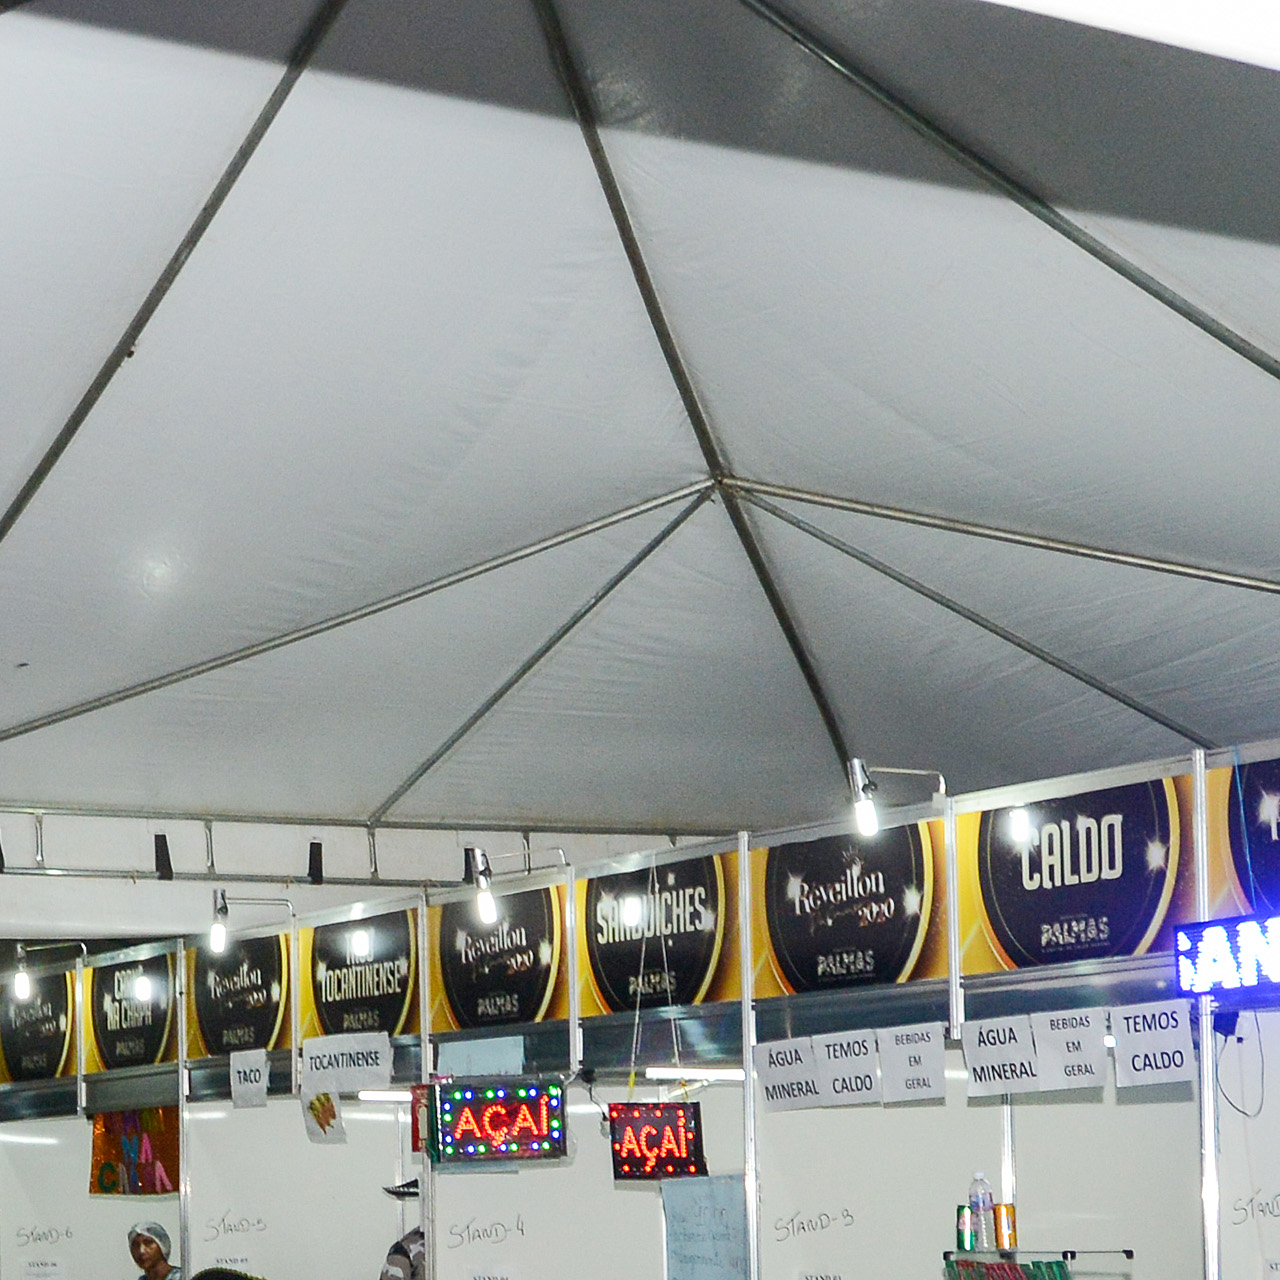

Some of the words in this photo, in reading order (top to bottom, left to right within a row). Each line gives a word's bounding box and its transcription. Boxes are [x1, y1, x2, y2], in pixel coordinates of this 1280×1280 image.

[1021, 814, 1124, 891] CALDO
[1041, 917, 1110, 947] PALMAS
[817, 950, 876, 977] PALMAS
[321, 960, 402, 1003] TOCANTINENSE
[1050, 1016, 1091, 1031] BEBIDAS
[1124, 1011, 1179, 1033] TEMOS
[895, 1032, 932, 1046] BEBIDAS
[977, 1024, 1018, 1047] ÁGUA
[768, 1046, 803, 1068] ÁGUA
[825, 1040, 869, 1060] TEMOS
[1066, 1041, 1082, 1053] EM
[309, 1051, 380, 1071] TOCANTINENSE
[909, 1056, 923, 1067] EM
[1064, 1064, 1096, 1077] GERAL
[1132, 1050, 1184, 1072] CALDO
[236, 1069, 261, 1084] TACO
[972, 1061, 1037, 1083] MINERAL
[765, 1080, 819, 1101] MINERAL
[832, 1075, 873, 1095] CALDO
[905, 1077, 932, 1090] GERAL
[448, 1213, 526, 1249] STAND-4
[774, 1208, 855, 1242] STAND-3
